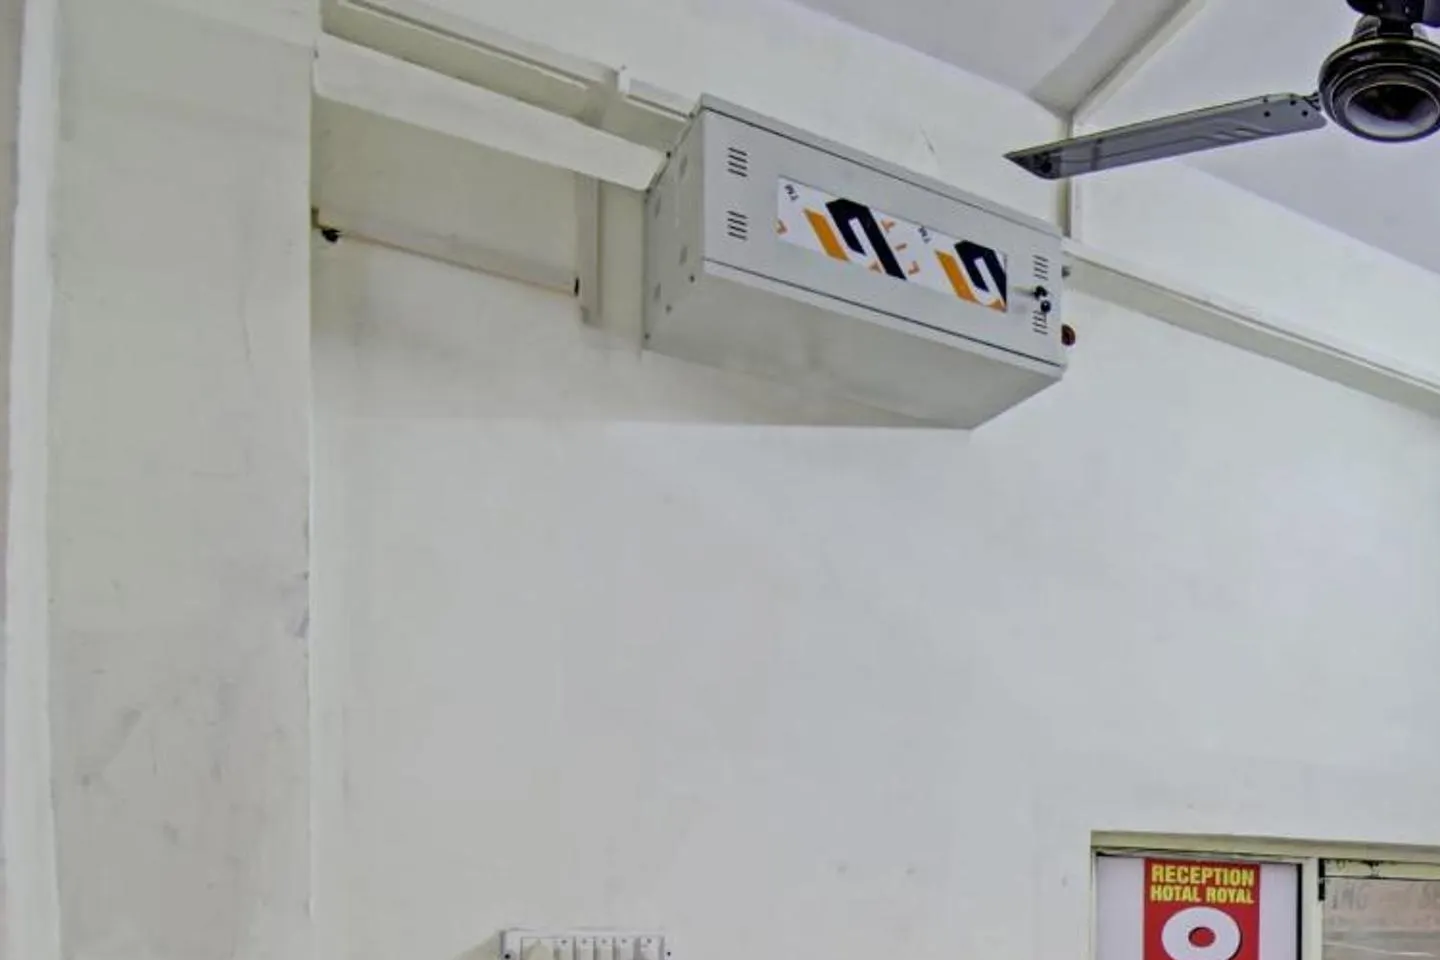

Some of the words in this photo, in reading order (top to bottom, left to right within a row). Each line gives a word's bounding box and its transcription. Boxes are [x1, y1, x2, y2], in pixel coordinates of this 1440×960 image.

[1151, 863, 1255, 886] RECEPTION
[1150, 884, 1202, 903] HOTAL
[1206, 886, 1255, 904] ROYAL
